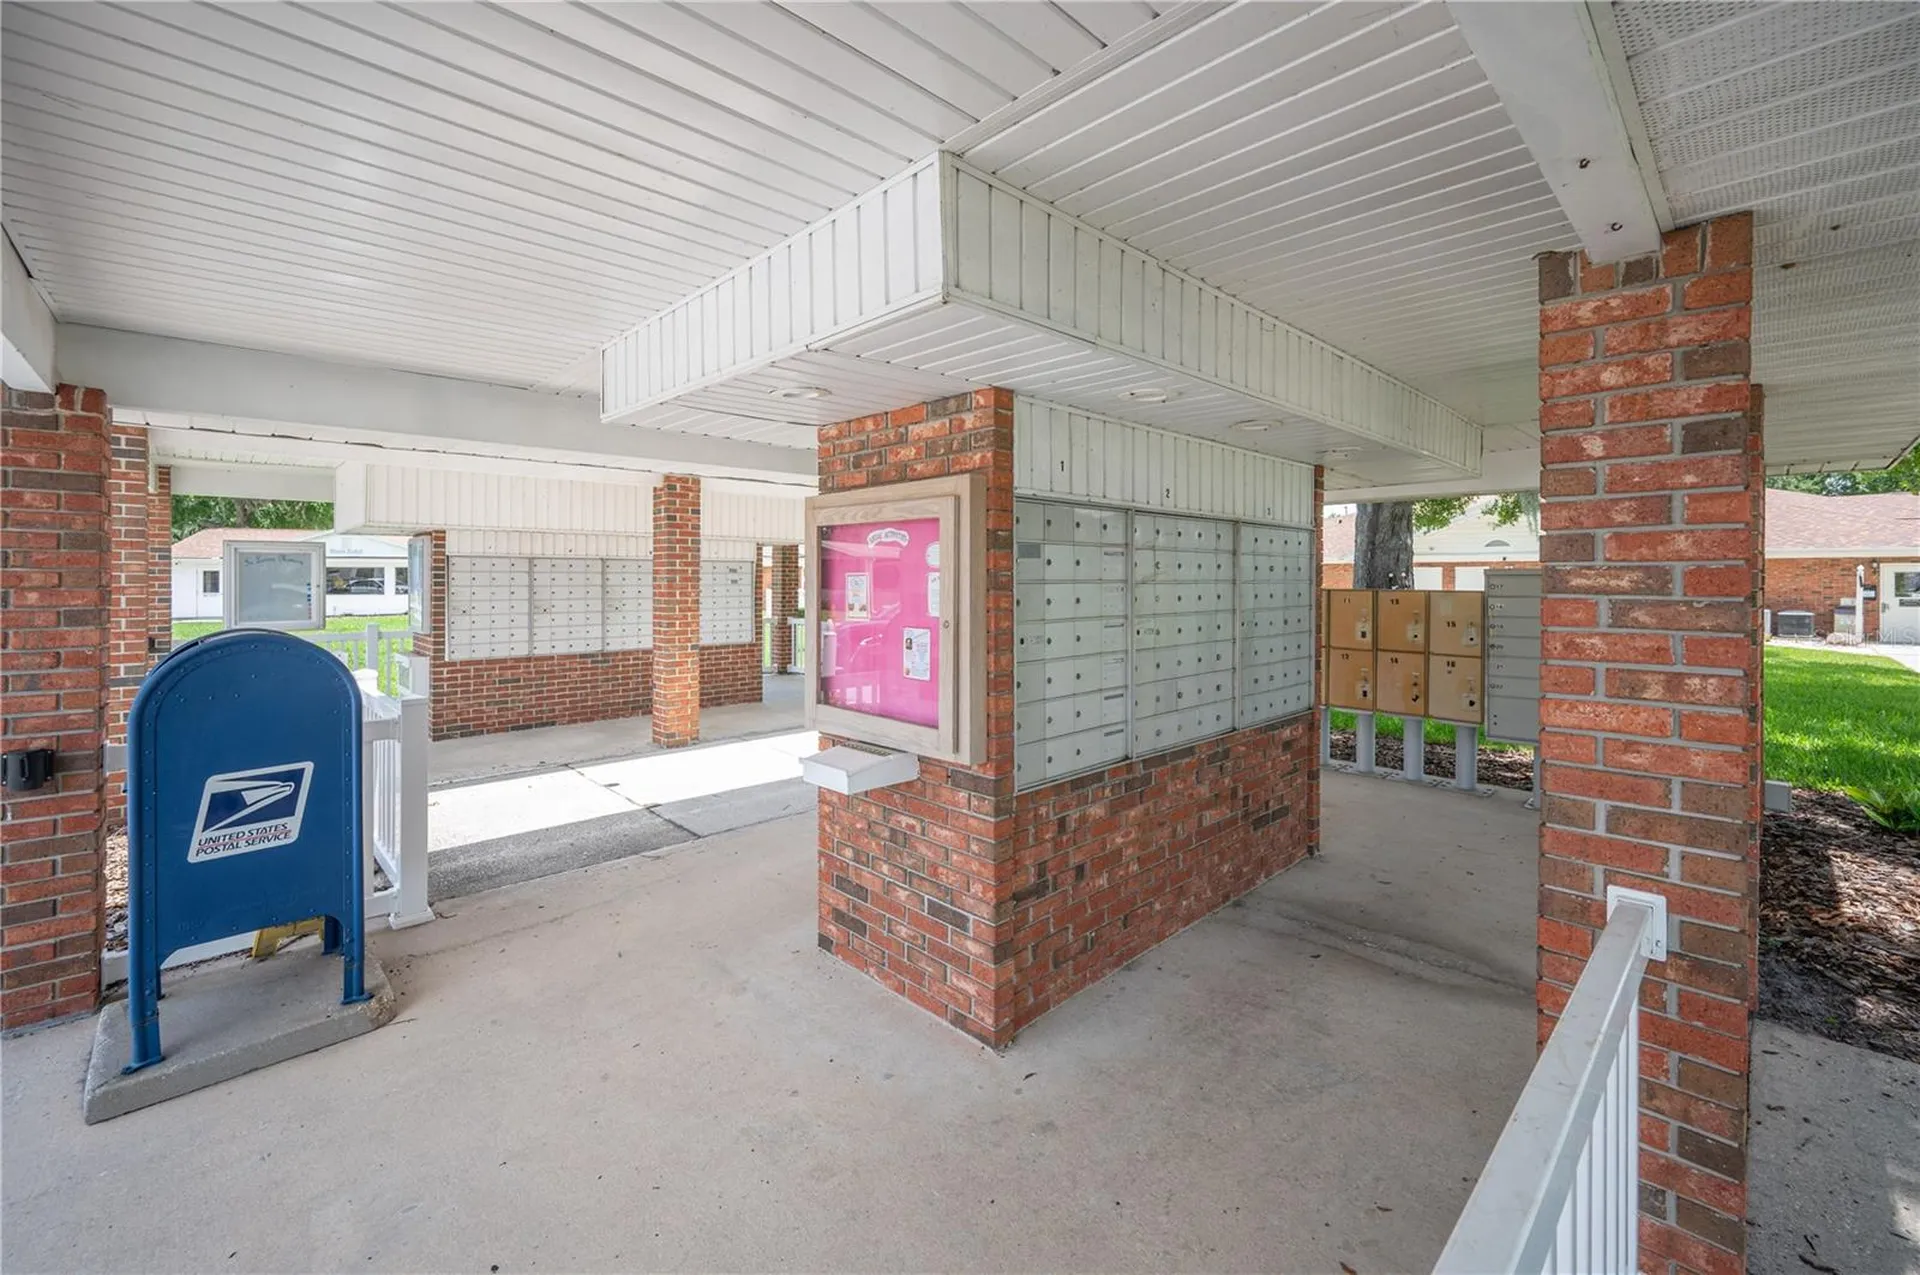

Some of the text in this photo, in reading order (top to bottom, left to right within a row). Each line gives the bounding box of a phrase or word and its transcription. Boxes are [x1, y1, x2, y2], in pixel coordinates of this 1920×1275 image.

[1060, 460, 1065, 472] 1
[1165, 488, 1171, 499] 2
[198, 822, 288, 846] UNITED STATES
[195, 830, 292, 857] POSTAL SERVICE
